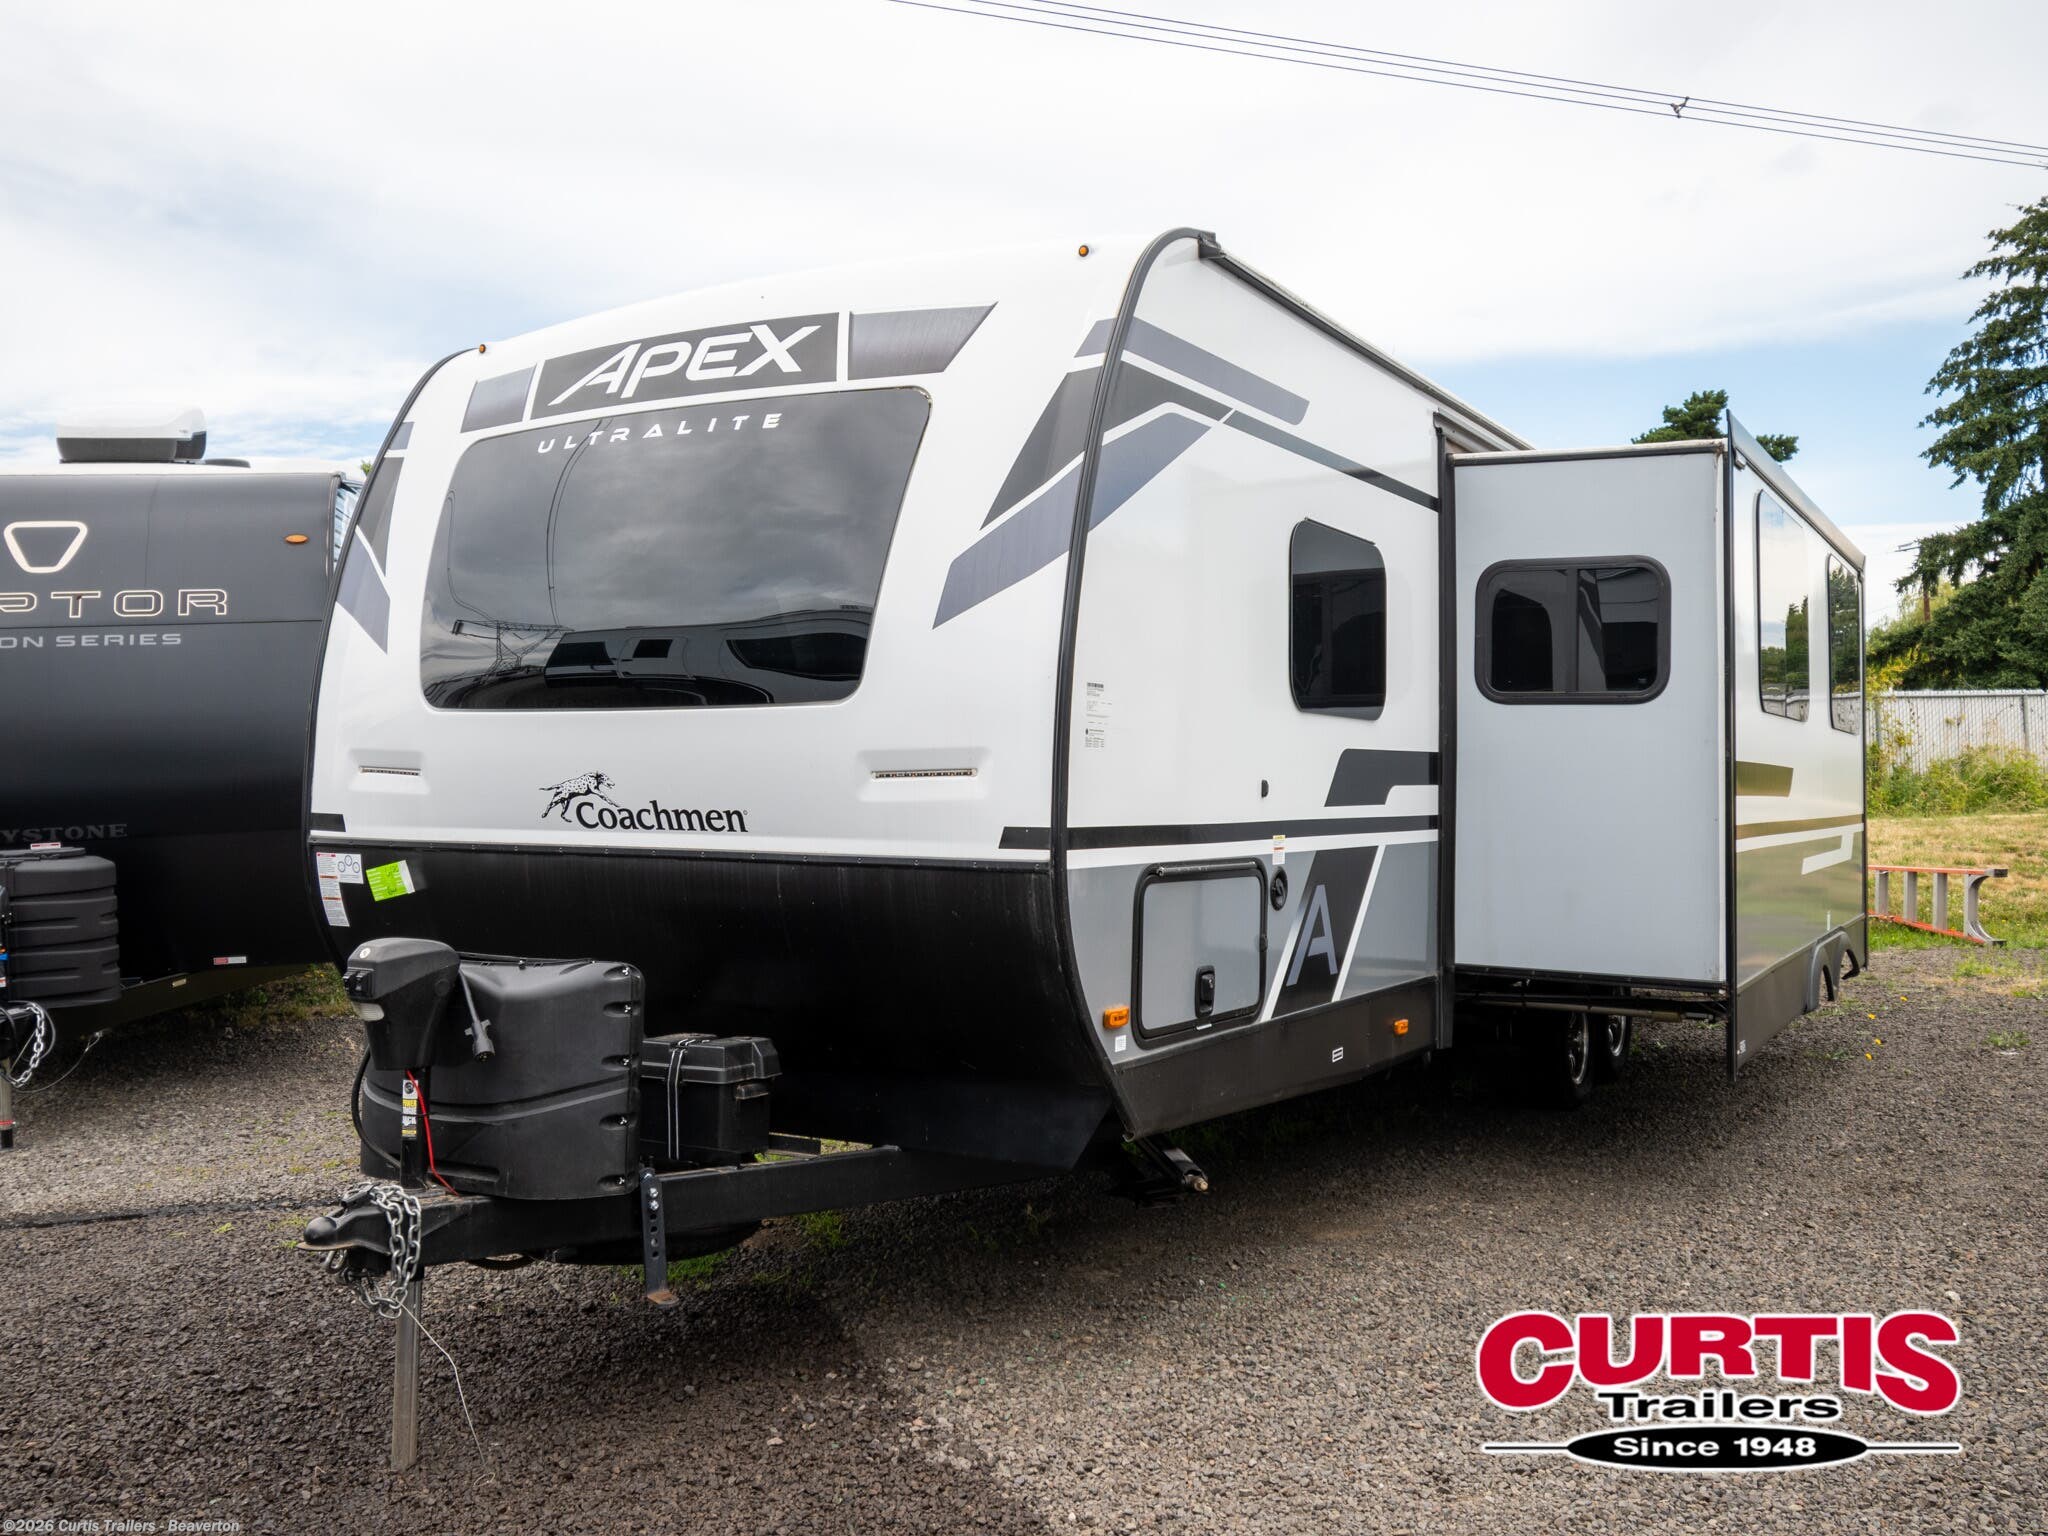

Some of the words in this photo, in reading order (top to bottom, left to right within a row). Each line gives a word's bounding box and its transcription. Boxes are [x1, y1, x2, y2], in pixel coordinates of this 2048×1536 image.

[547, 324, 822, 407] APEX
[537, 413, 783, 454] ULTRALITE
[0, 588, 228, 619] PTOR
[55, 633, 182, 648] SERIES
[575, 799, 749, 833] Coachmen
